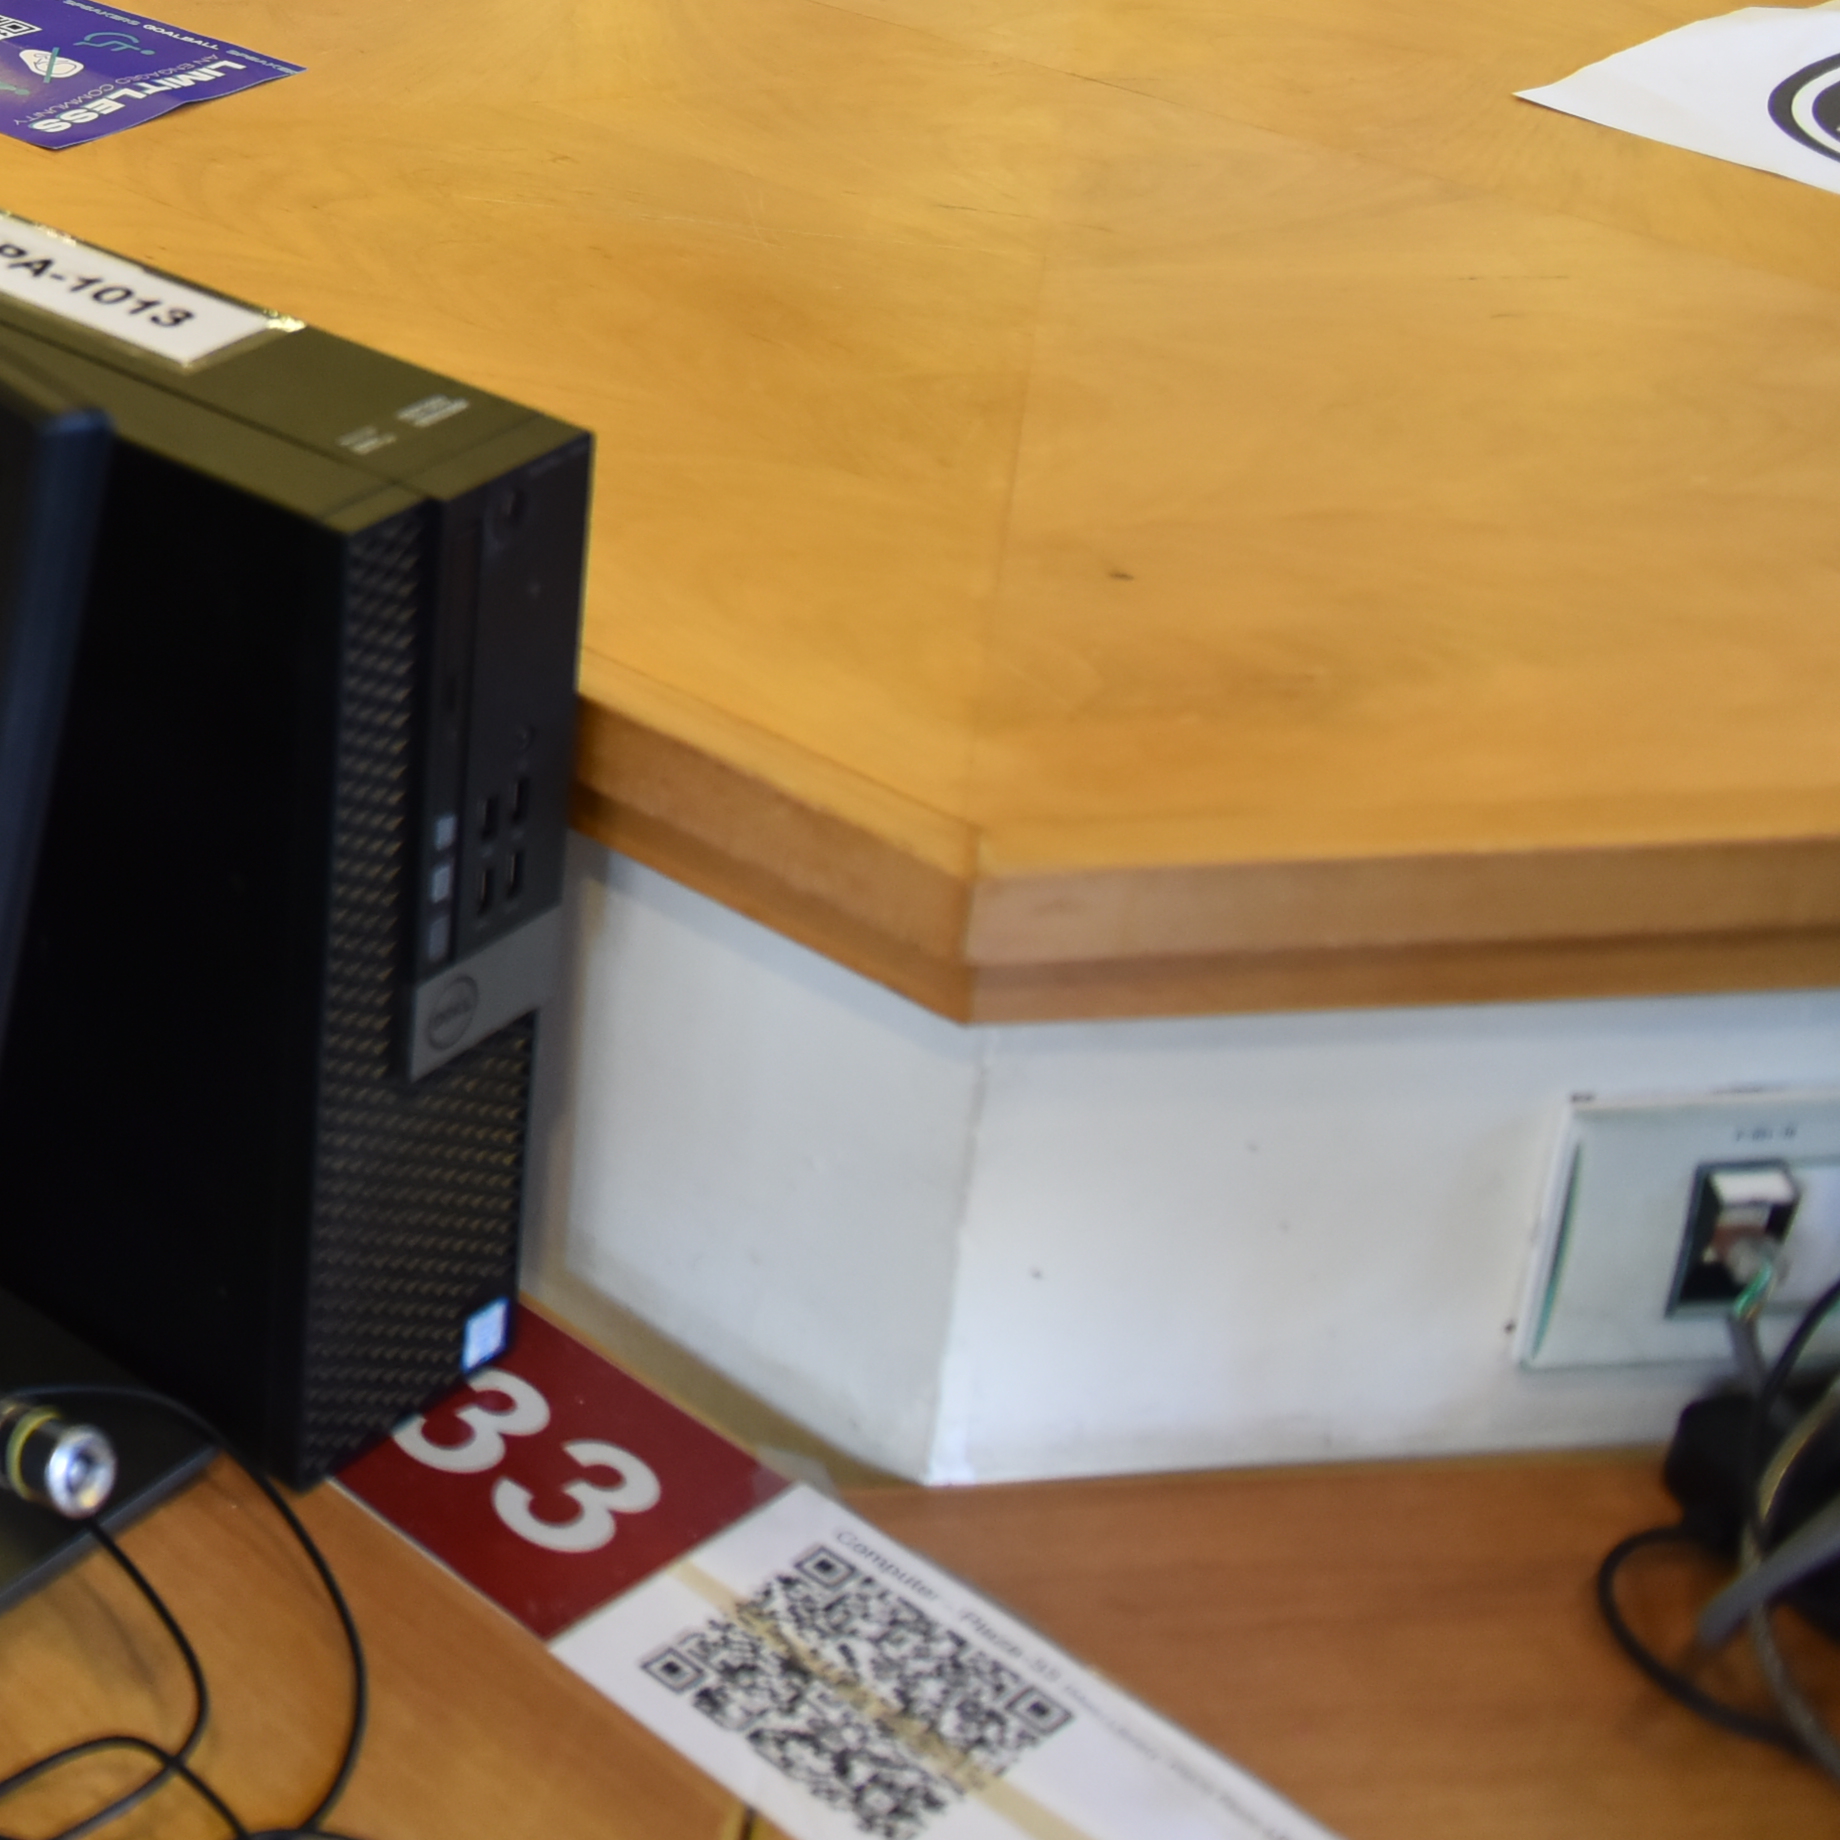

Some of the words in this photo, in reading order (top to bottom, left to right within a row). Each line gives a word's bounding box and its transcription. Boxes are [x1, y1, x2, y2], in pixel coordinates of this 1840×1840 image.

[63, 0, 143, 27] SPEAKERS
[143, 24, 219, 50] GOALBALL
[115, 62, 196, 85] ENGAGED
[197, 53, 219, 66] AN
[13, 83, 115, 126] COMMUNITY
[28, 59, 248, 133] LIMITLESS
[391, 1367, 661, 1554] 33
[833, 1529, 939, 1601] Computer
